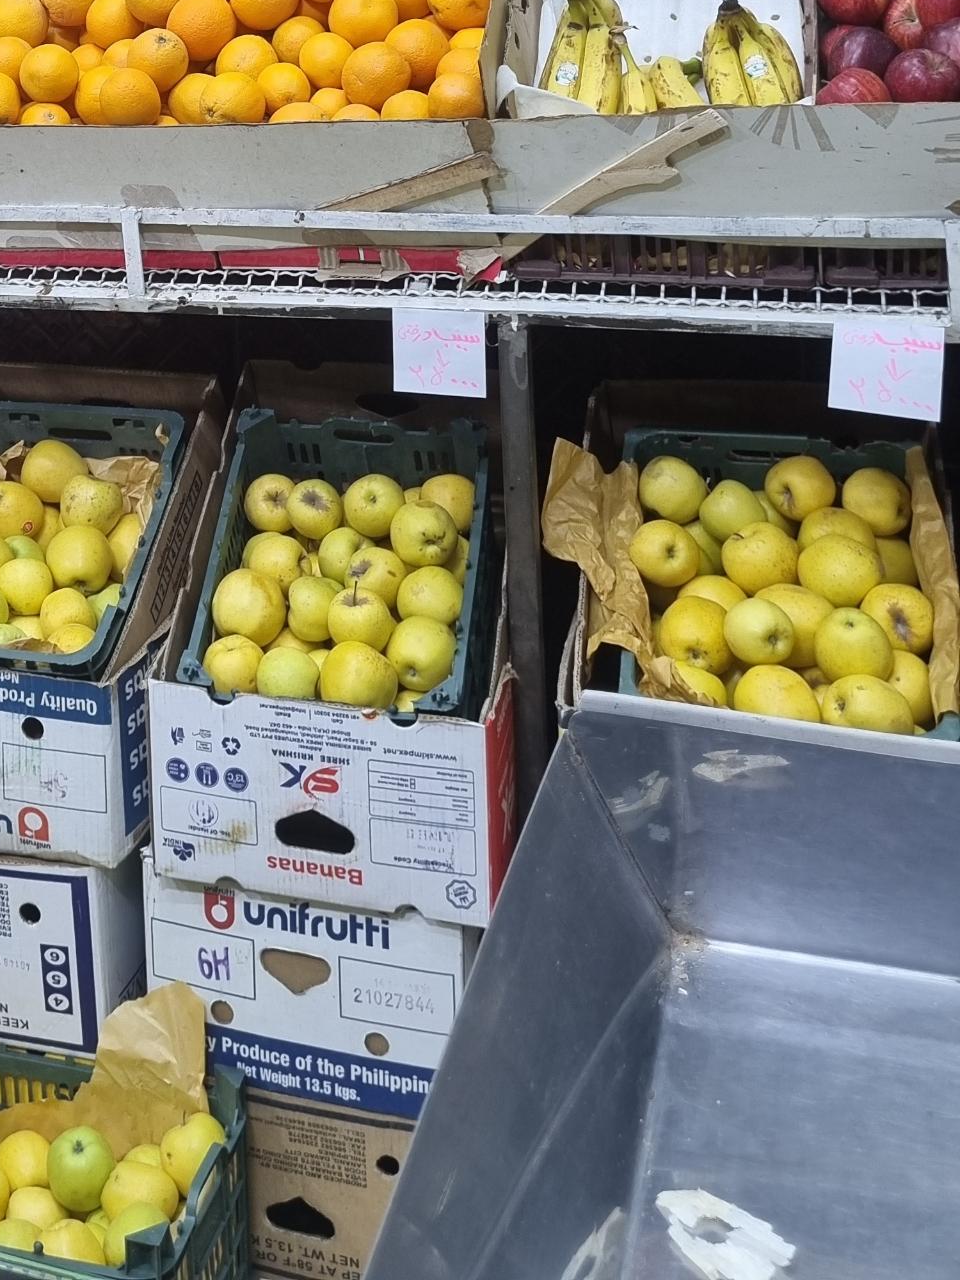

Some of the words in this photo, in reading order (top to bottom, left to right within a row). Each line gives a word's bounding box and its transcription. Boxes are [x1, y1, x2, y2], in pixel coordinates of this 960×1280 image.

[41, 692, 98, 717] Quality
[271, 748, 314, 762] KRISHNA
[319, 754, 351, 767] SHREE
[382, 747, 458, 764] www.skimpex.net
[20, 838, 51, 851] unifrutti
[266, 855, 363, 886] Bananas
[243, 900, 390, 950] unifrutti
[198, 946, 231, 981] 6H
[352, 987, 435, 1015] 21027844
[221, 1036, 290, 1067] Produce
[295, 1055, 313, 1072] of
[316, 1058, 345, 1078] the
[350, 1064, 431, 1095] Philippin
[259, 1067, 301, 1089] Weight
[304, 1077, 332, 1096] 13.5
[334, 1081, 361, 1102] kgs.
[264, 1238, 294, 1253] 13.5
[298, 1245, 326, 1261] WT.
[331, 1252, 360, 1269] NET
[318, 1264, 337, 1277] AT
